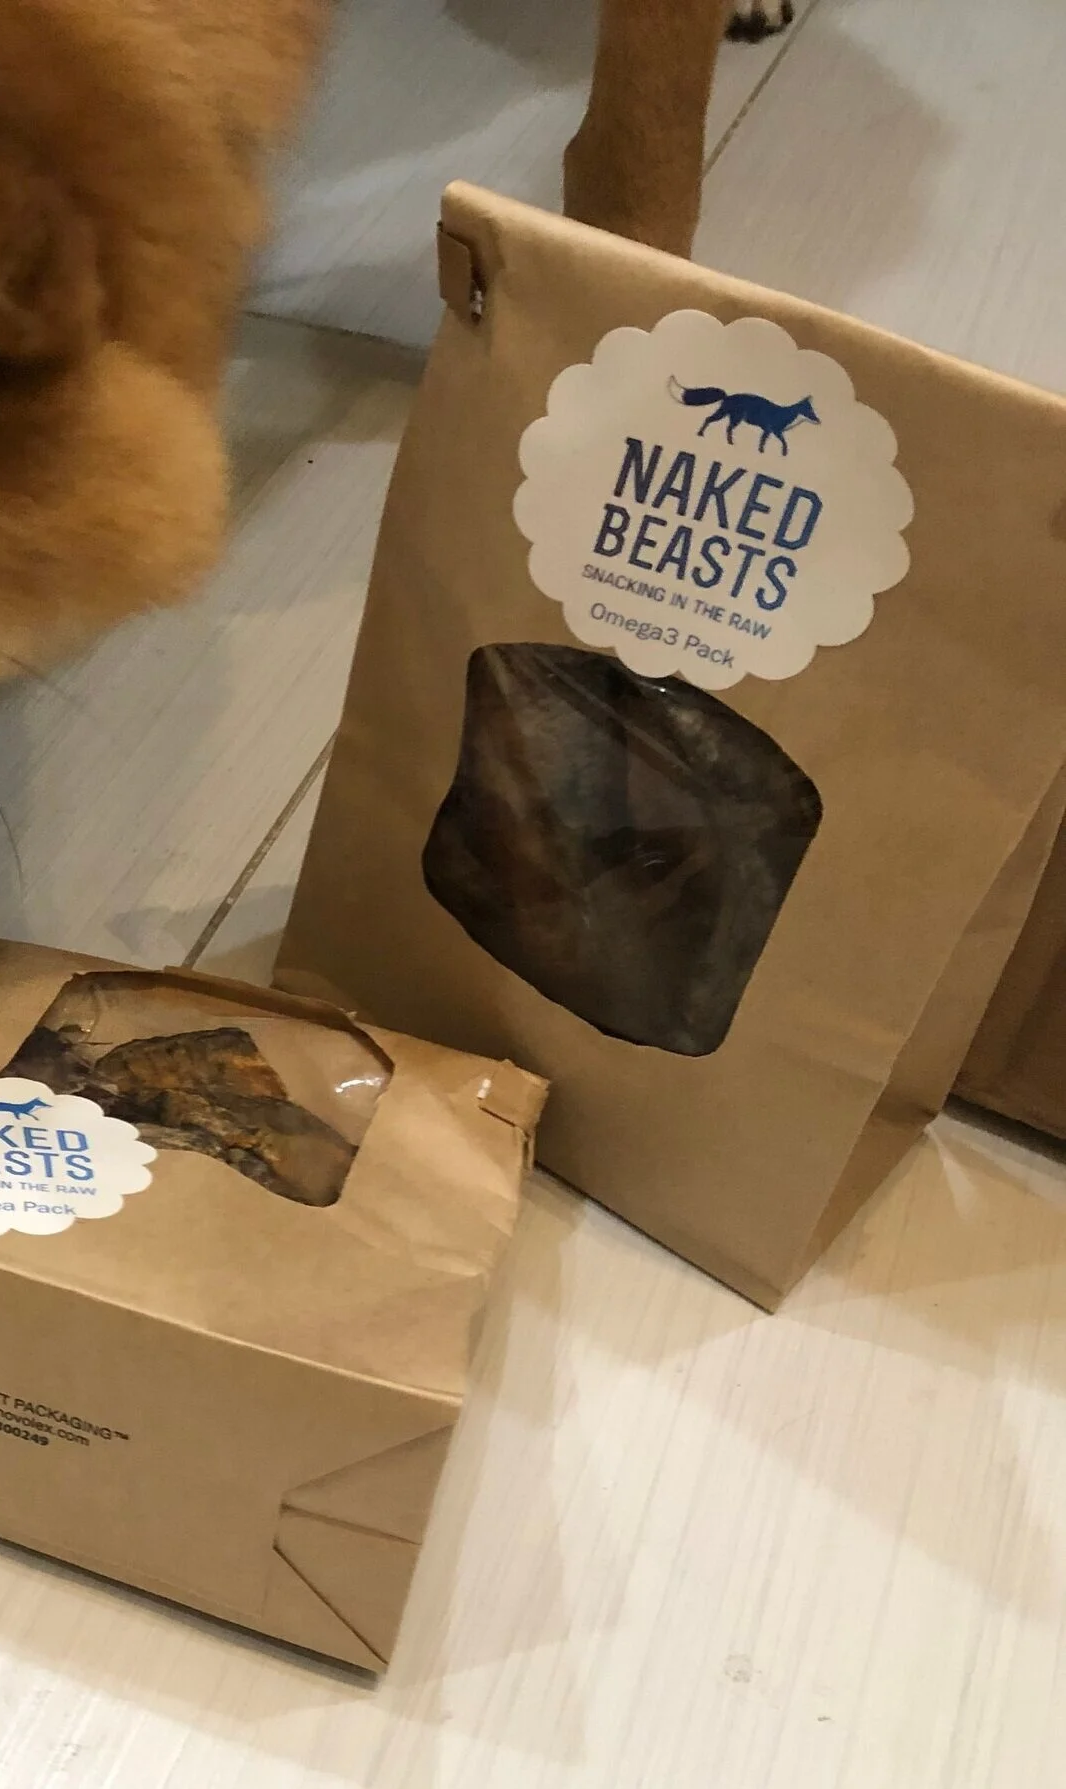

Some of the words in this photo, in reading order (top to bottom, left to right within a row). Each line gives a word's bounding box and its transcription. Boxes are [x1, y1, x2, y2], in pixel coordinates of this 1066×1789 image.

[613, 437, 822, 551] NAKED
[593, 503, 797, 612] BEASTS
[581, 563, 665, 603] SNACKING
[671, 593, 689, 609] IN
[694, 598, 724, 624] THE
[728, 610, 772, 641] RAW
[589, 602, 679, 647] Omega3
[684, 633, 735, 669] Pack
[19, 1181, 49, 1193] THE
[55, 1184, 97, 1196] RAW
[23, 1200, 78, 1216] Pack
